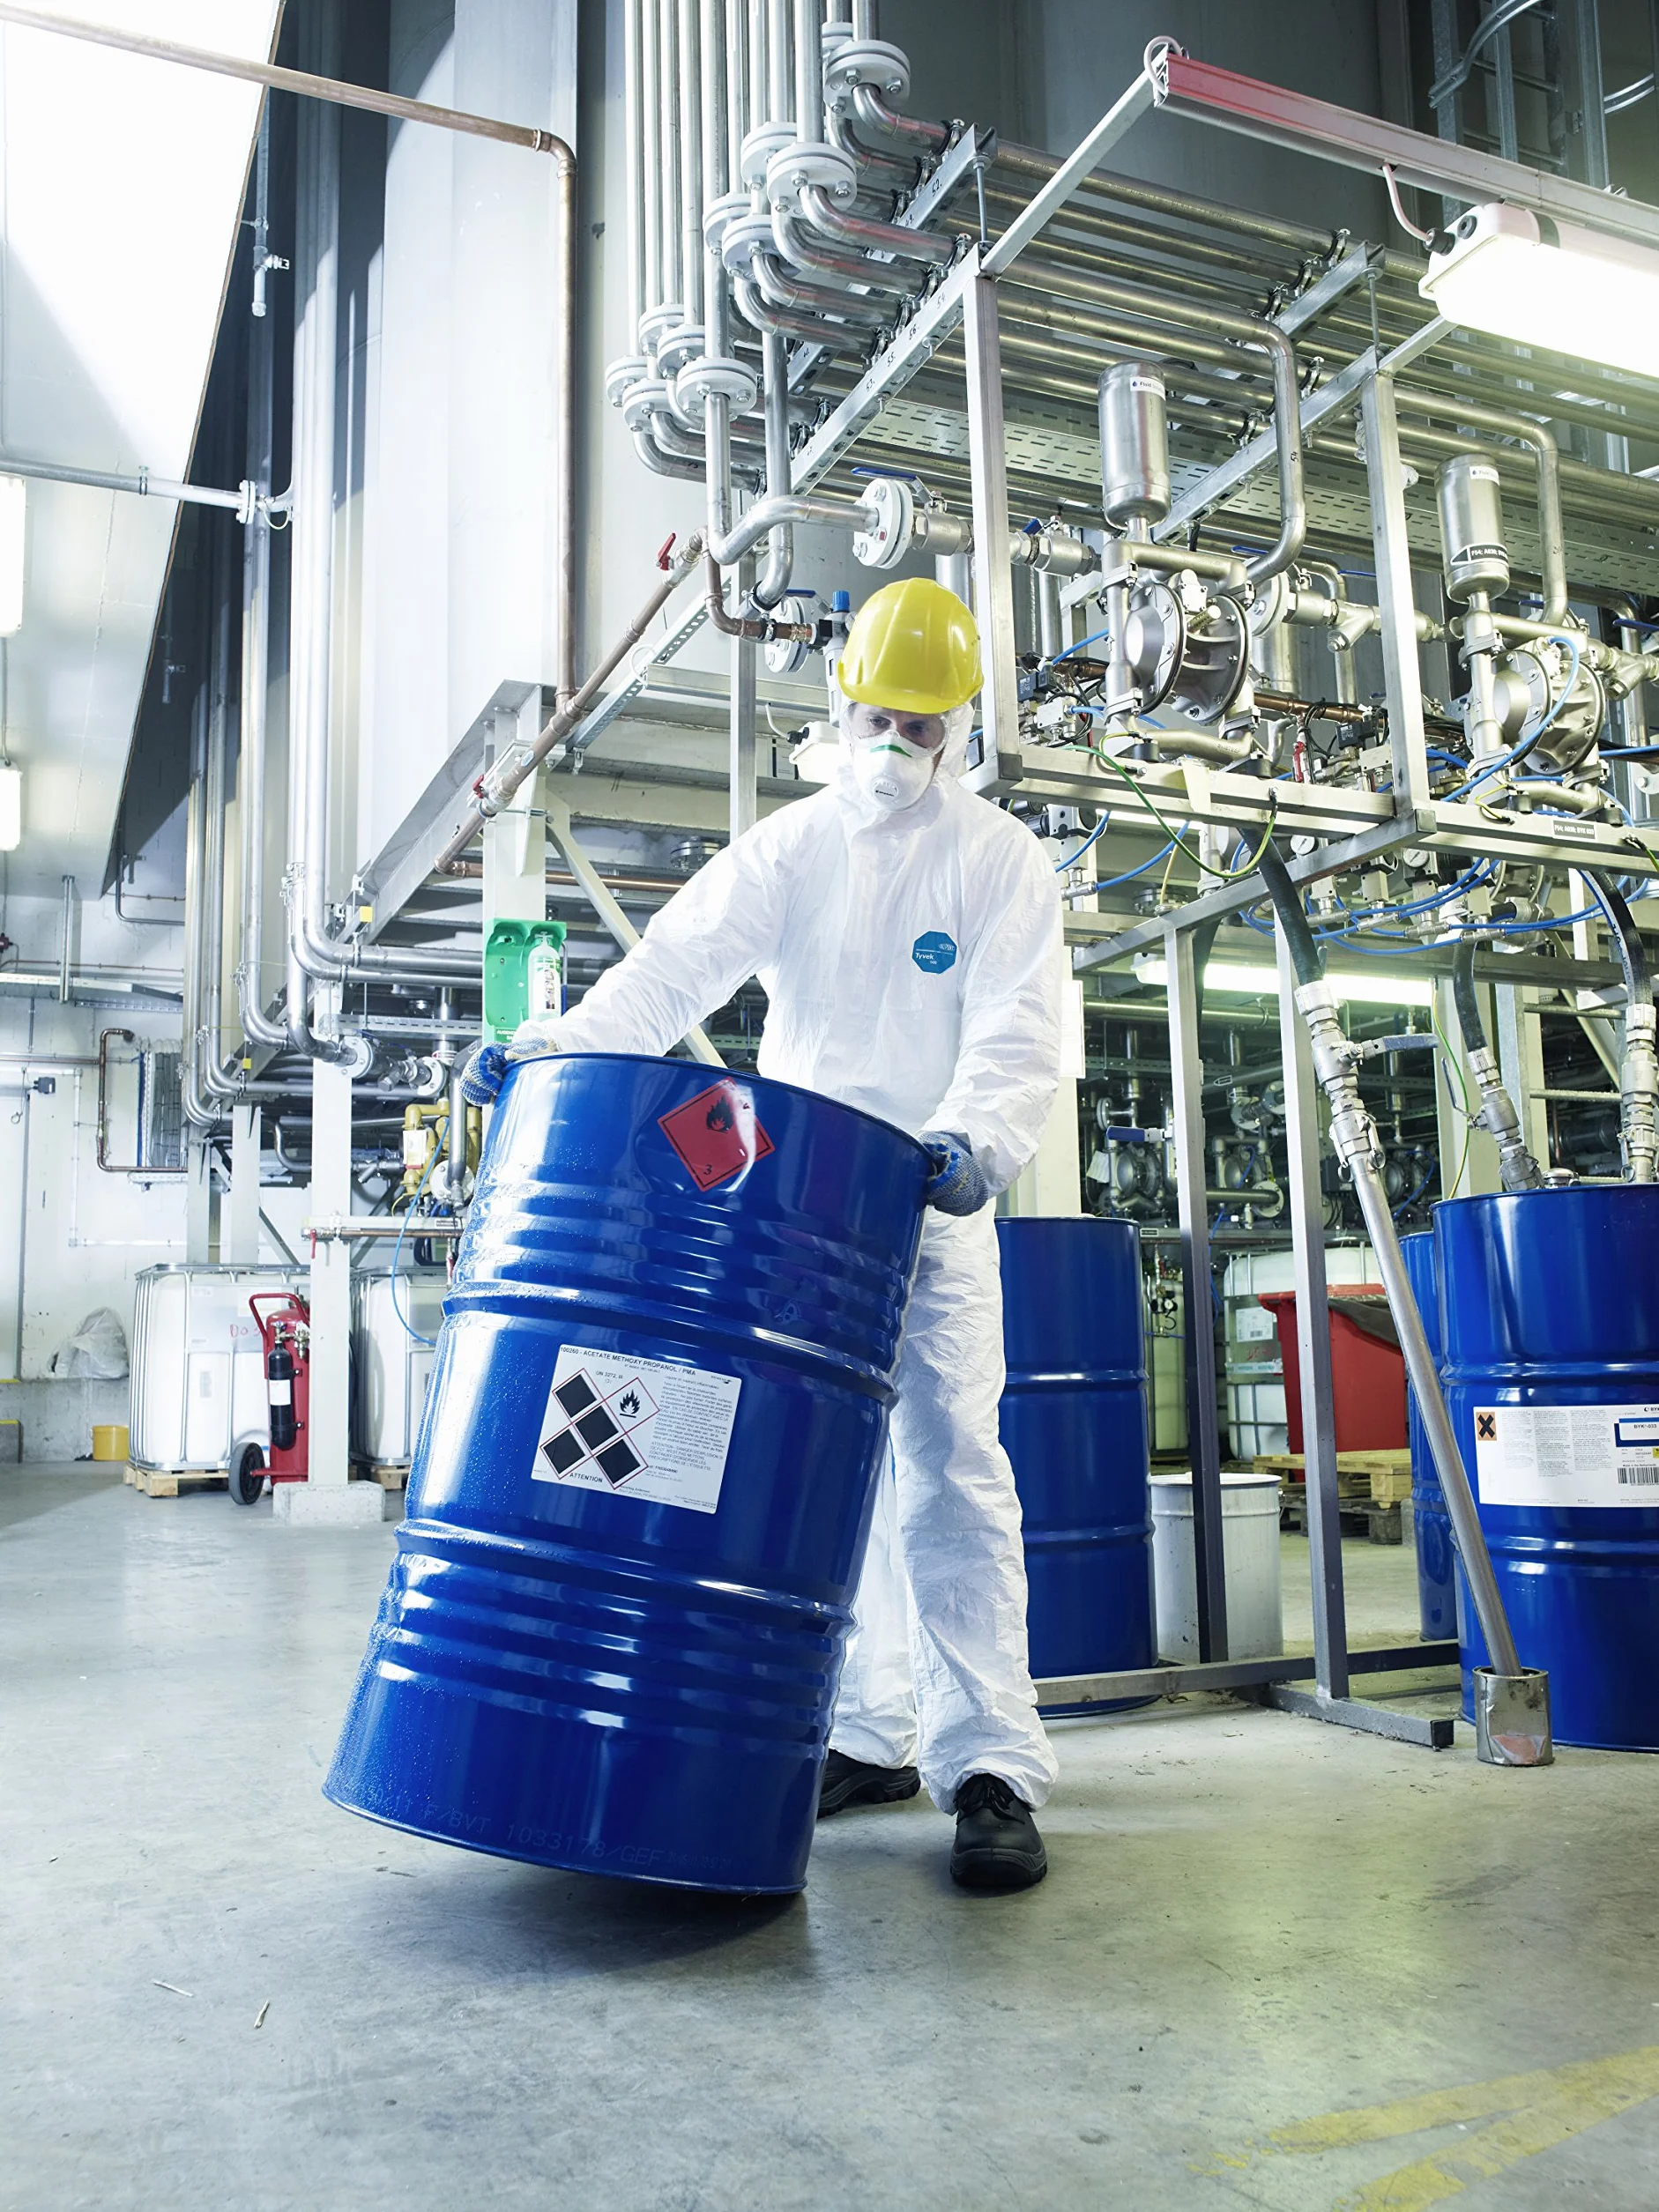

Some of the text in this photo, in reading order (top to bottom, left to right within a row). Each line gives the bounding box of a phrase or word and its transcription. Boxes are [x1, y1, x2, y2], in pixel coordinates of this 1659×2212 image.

[703, 1164, 712, 1175] 3
[612, 1355, 643, 1365] METHOXY
[644, 1361, 677, 1372] PROPANOL
[569, 1473, 603, 1482] ATTENTION
